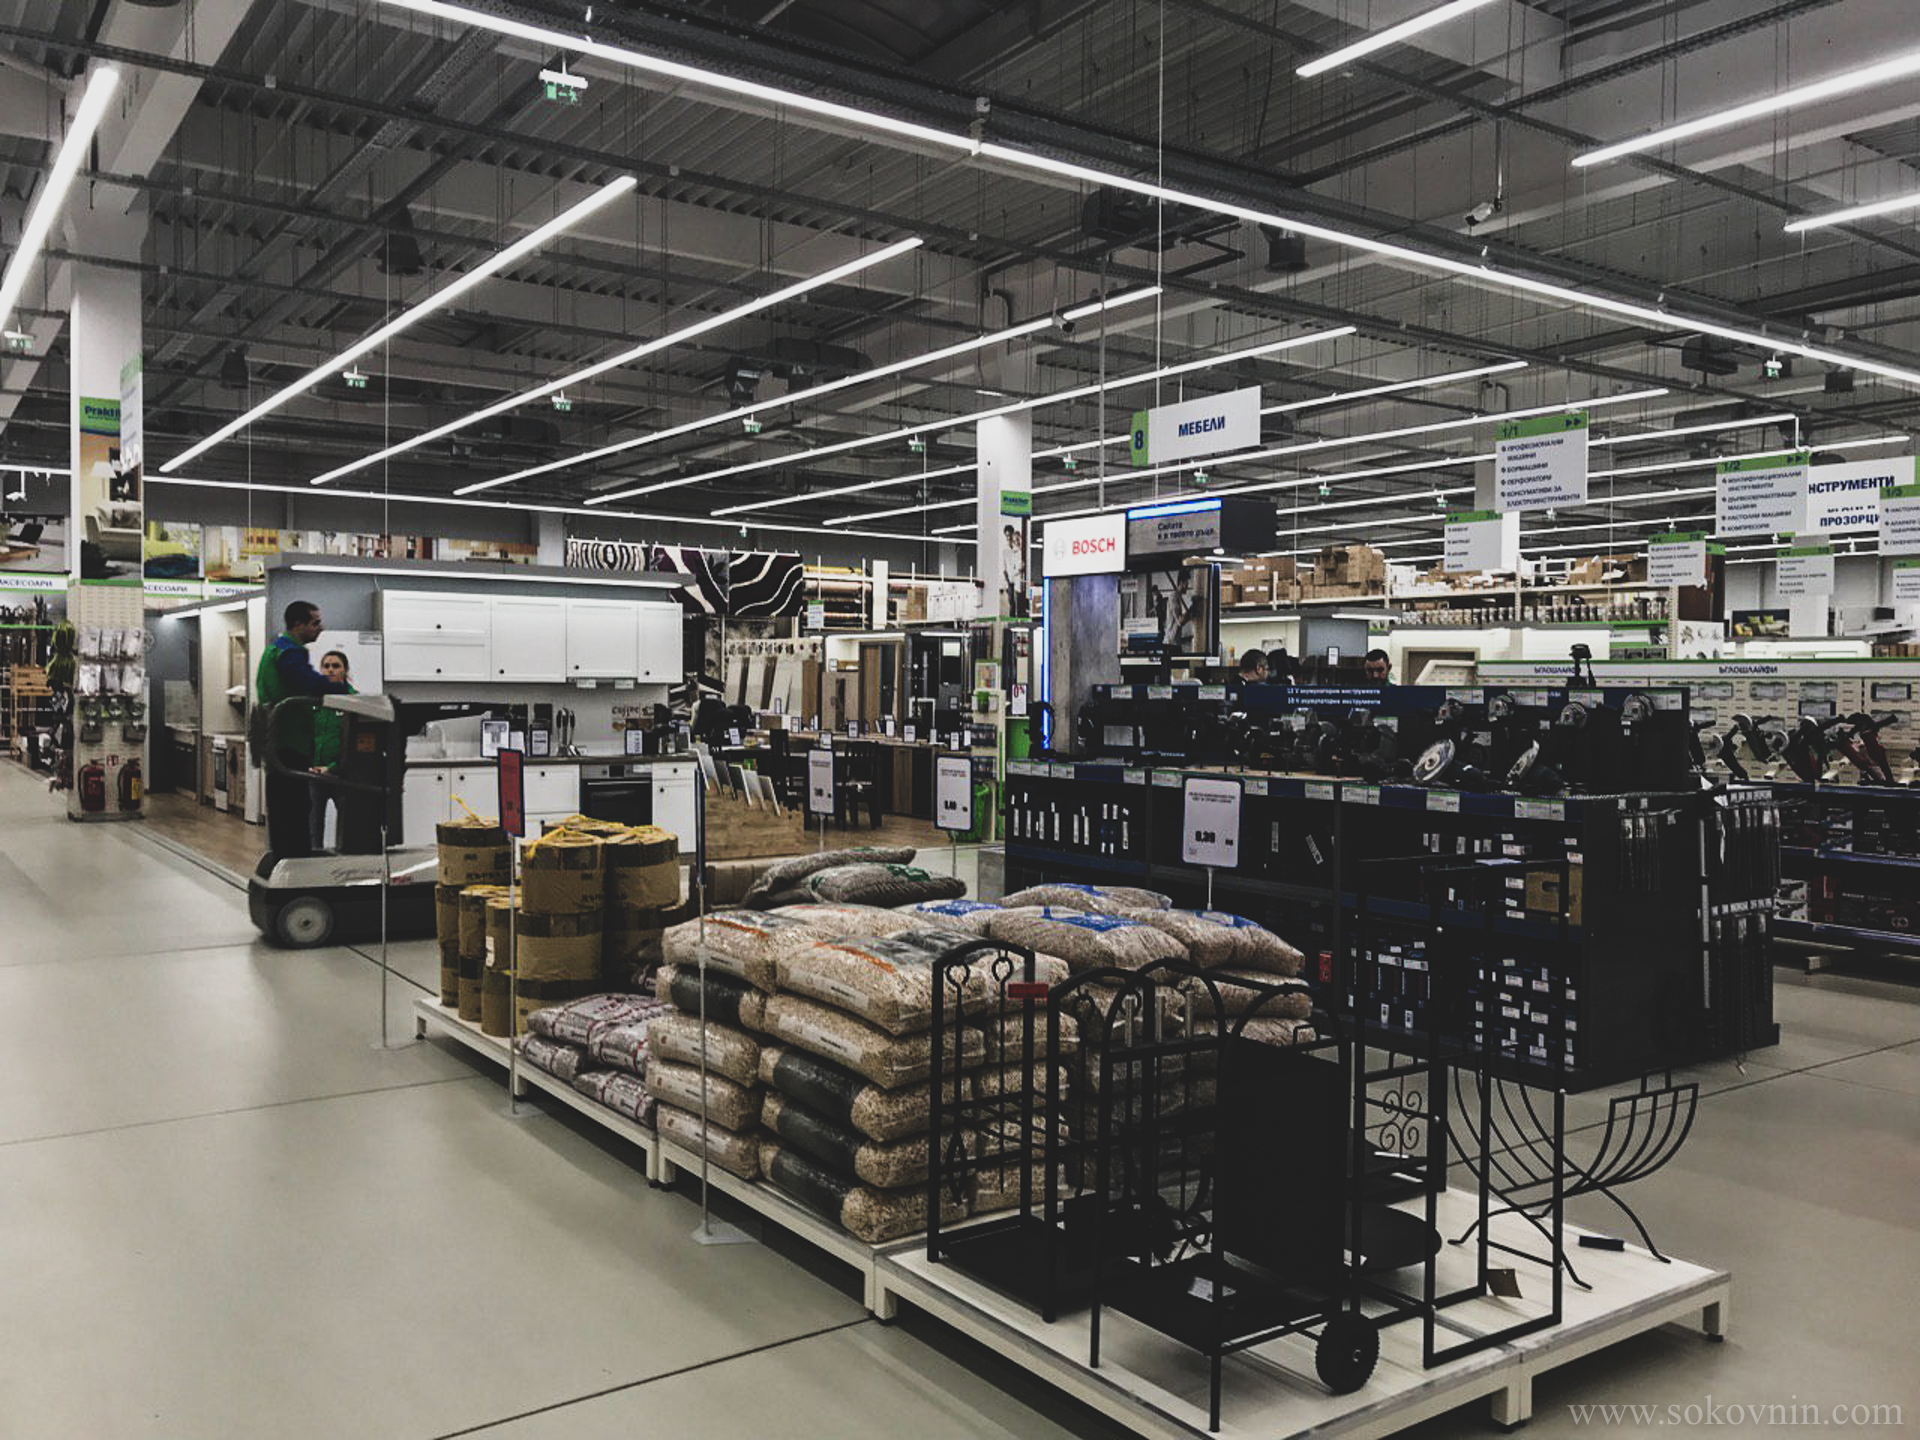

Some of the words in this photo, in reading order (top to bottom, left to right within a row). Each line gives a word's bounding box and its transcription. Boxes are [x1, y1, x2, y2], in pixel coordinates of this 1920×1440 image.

[84, 405, 120, 418] Prakti
[1178, 416, 1225, 437] МЕБЕЛИ
[1134, 430, 1144, 450] 8
[1808, 475, 1895, 494] НСТРУМЕНТИ
[1072, 537, 1116, 556] BOSCH
[1718, 665, 1778, 674] ЪГЛОШЛАЙФИ
